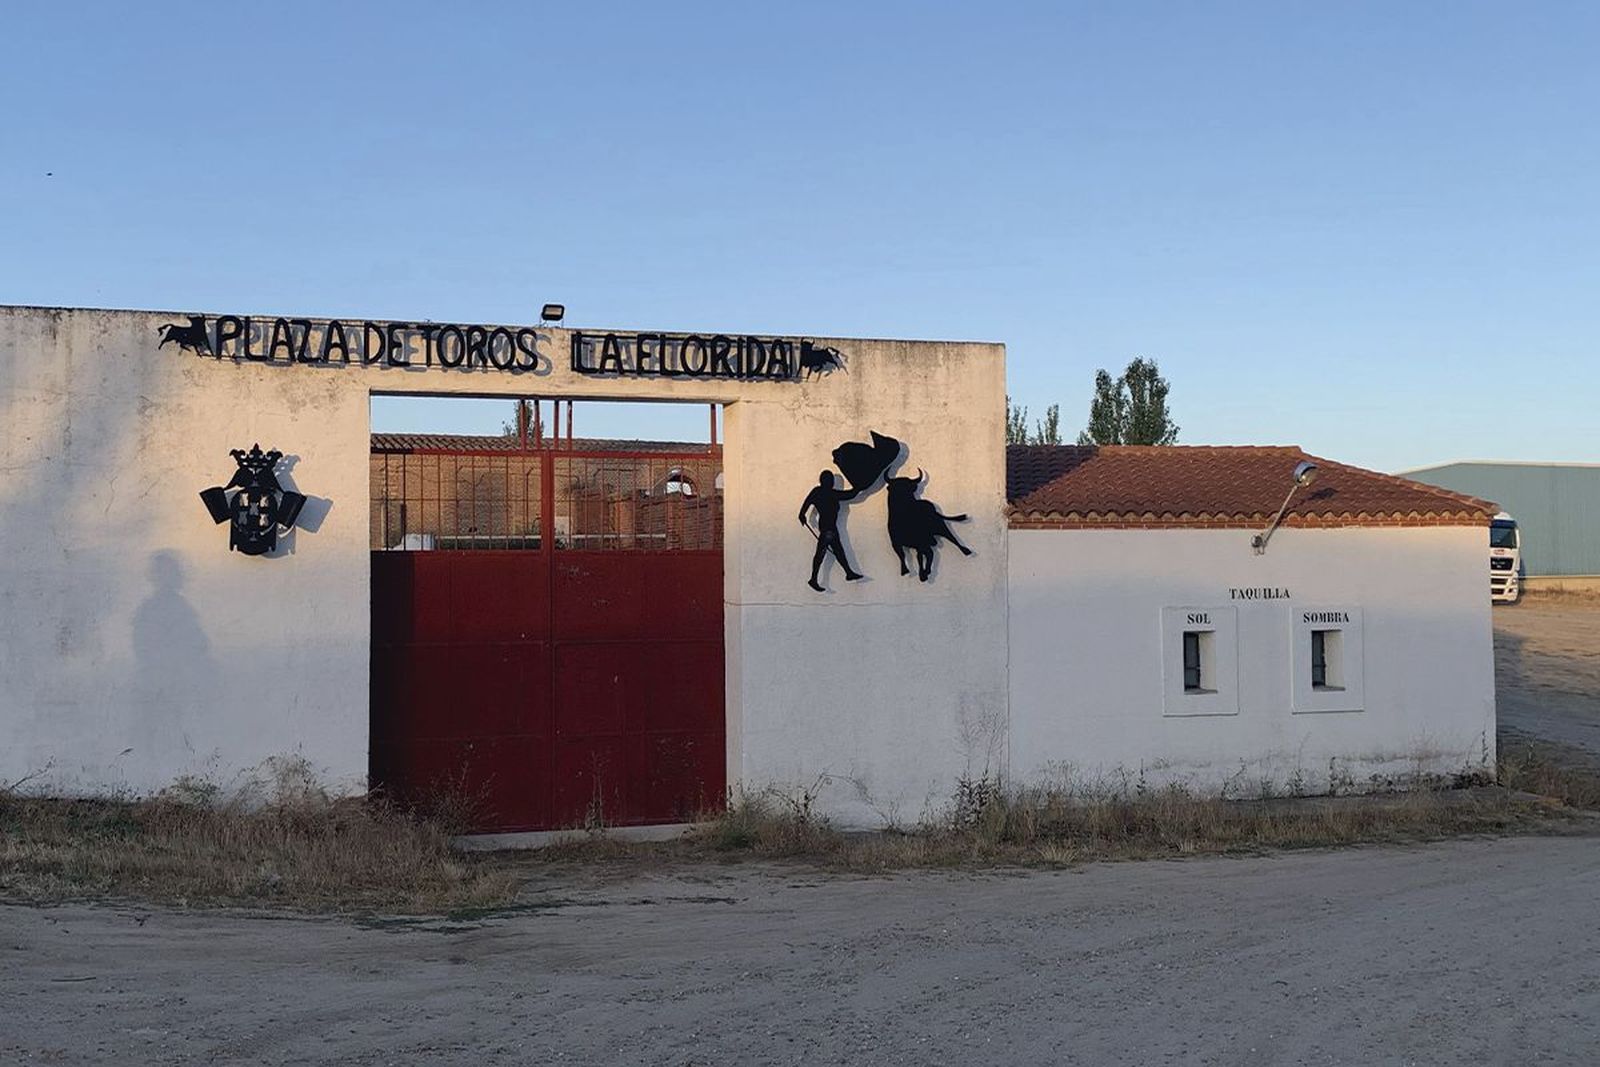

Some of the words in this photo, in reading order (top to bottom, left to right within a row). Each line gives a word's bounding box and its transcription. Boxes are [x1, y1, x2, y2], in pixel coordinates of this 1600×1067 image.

[216, 315, 349, 363] PLAZA
[364, 321, 410, 367] DE
[417, 324, 538, 371] TOROS
[573, 331, 624, 375] LA
[636, 334, 787, 378] FLORIDA
[1229, 588, 1290, 600] TAQUILLA
[1187, 613, 1211, 624] SOL
[1303, 612, 1350, 624] SOMBRA
